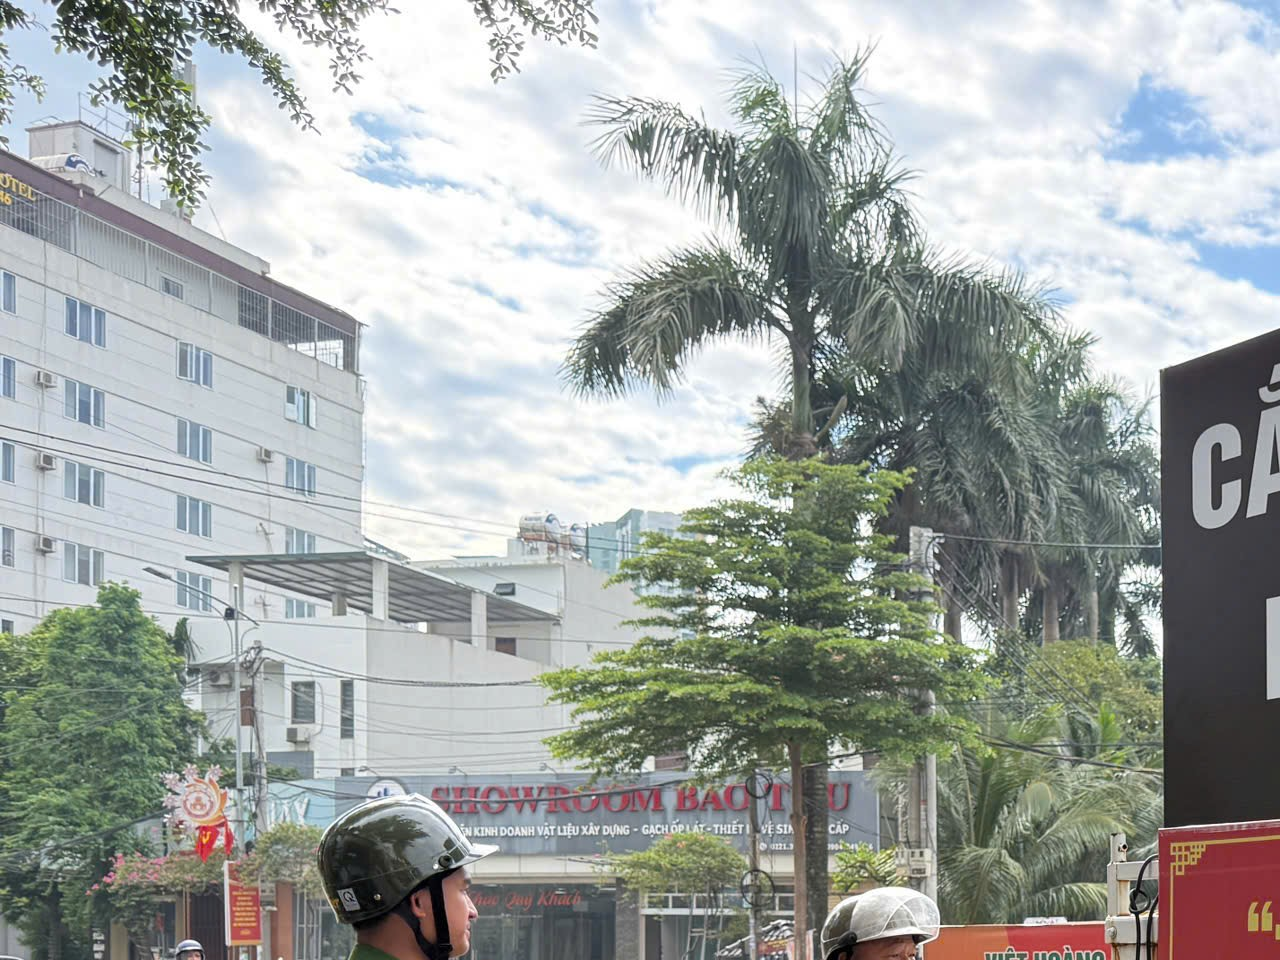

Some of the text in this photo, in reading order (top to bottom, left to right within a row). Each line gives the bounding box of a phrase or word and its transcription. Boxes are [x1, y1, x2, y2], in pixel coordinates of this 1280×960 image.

[431, 784, 663, 815] SHOWROOM
[766, 783, 852, 812] TU
[474, 825, 499, 837] KINH
[500, 825, 535, 837] DOANH
[537, 823, 556, 840] VẬT
[558, 823, 580, 839] LIỆU
[581, 822, 601, 836] XÂY
[602, 823, 630, 839] DỰNG
[642, 824, 669, 838] GẠCH
[713, 820, 745, 835] THIẾT
[829, 819, 850, 836] CẤP
